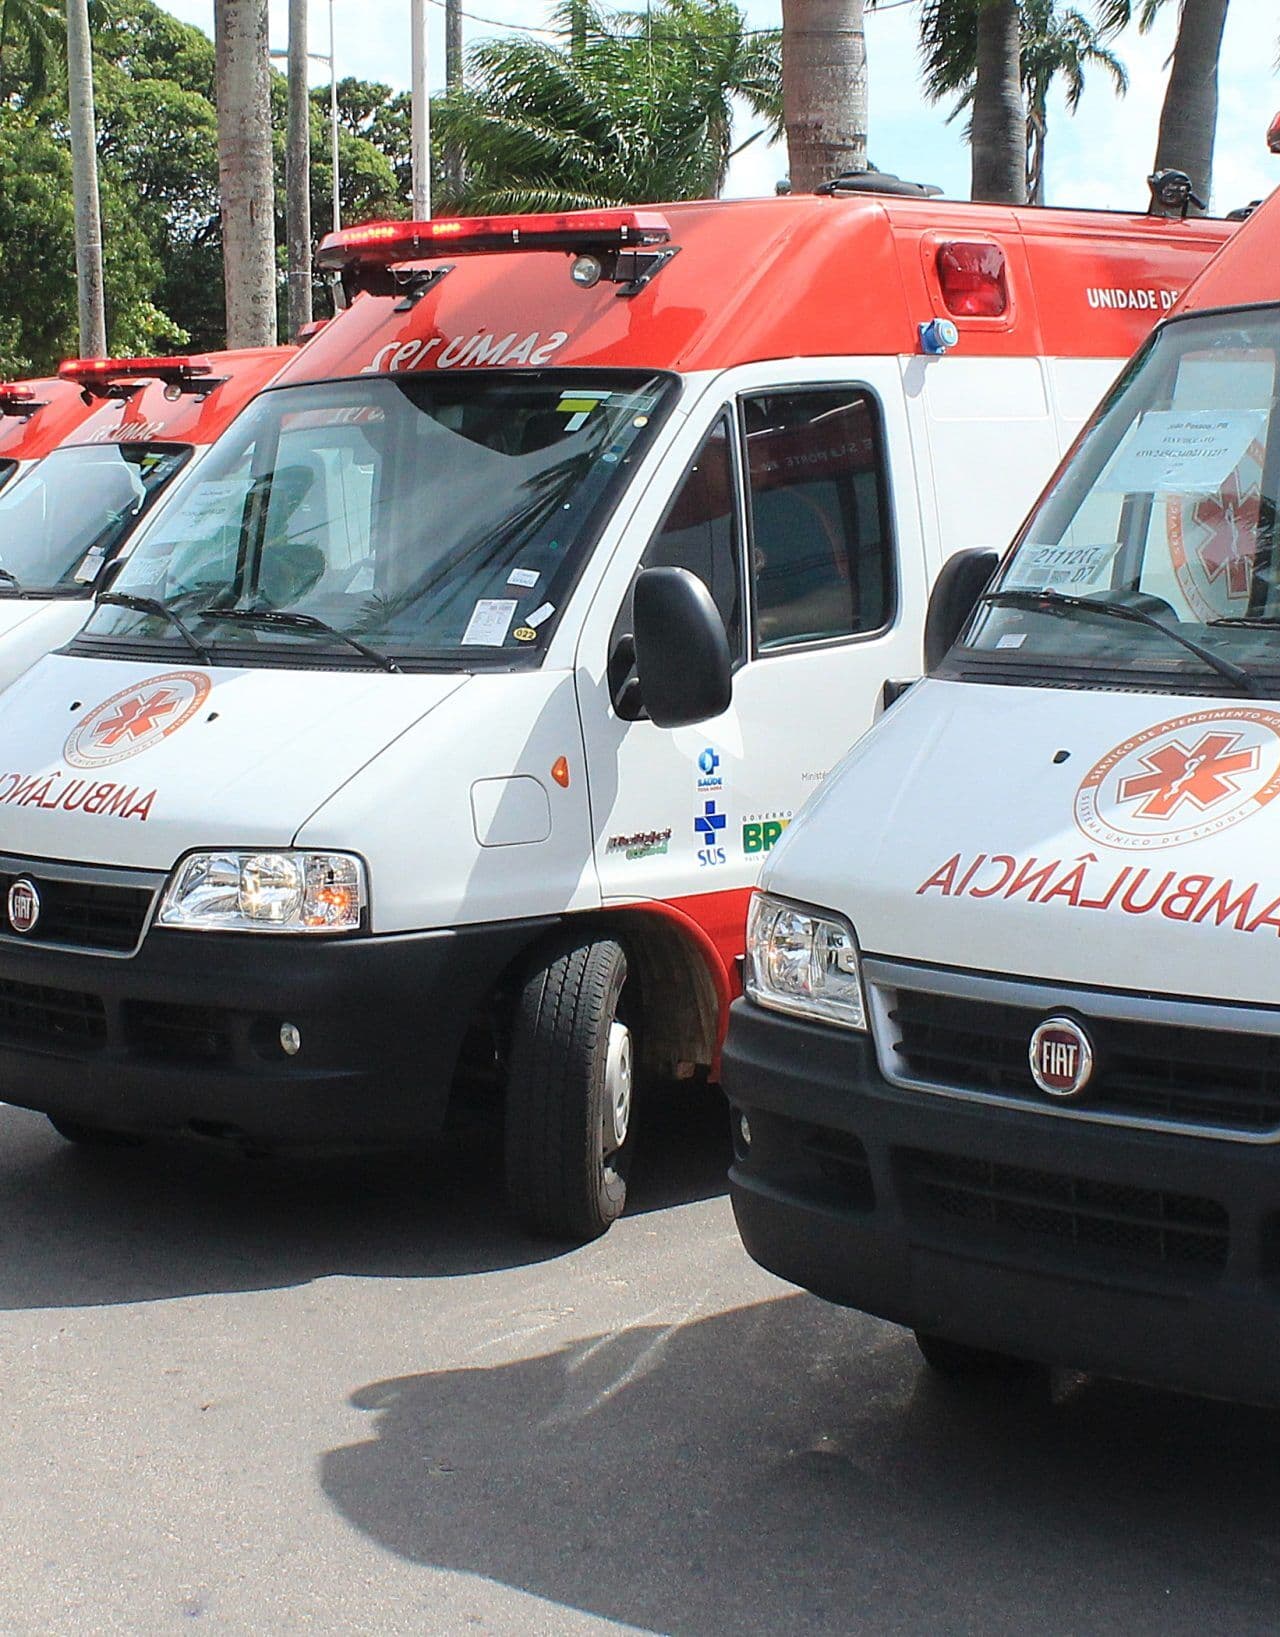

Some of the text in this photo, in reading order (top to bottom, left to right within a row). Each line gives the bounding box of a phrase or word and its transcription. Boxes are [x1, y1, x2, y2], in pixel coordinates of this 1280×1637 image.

[1086, 287, 1158, 309] UNIDADE
[516, 629, 534, 639] 022
[1090, 742, 1134, 780] SERVIÇO
[1138, 730, 1155, 742] DE
[1160, 710, 1261, 732] ATENDIMENTO
[743, 810, 793, 822] GOVERNO
[1080, 795, 1246, 846] SISTEMA ÚNICO DE SAÚDE
[697, 847, 726, 867] SUS
[14, 894, 33, 919] FIAT
[1042, 1040, 1077, 1078] FIAT
